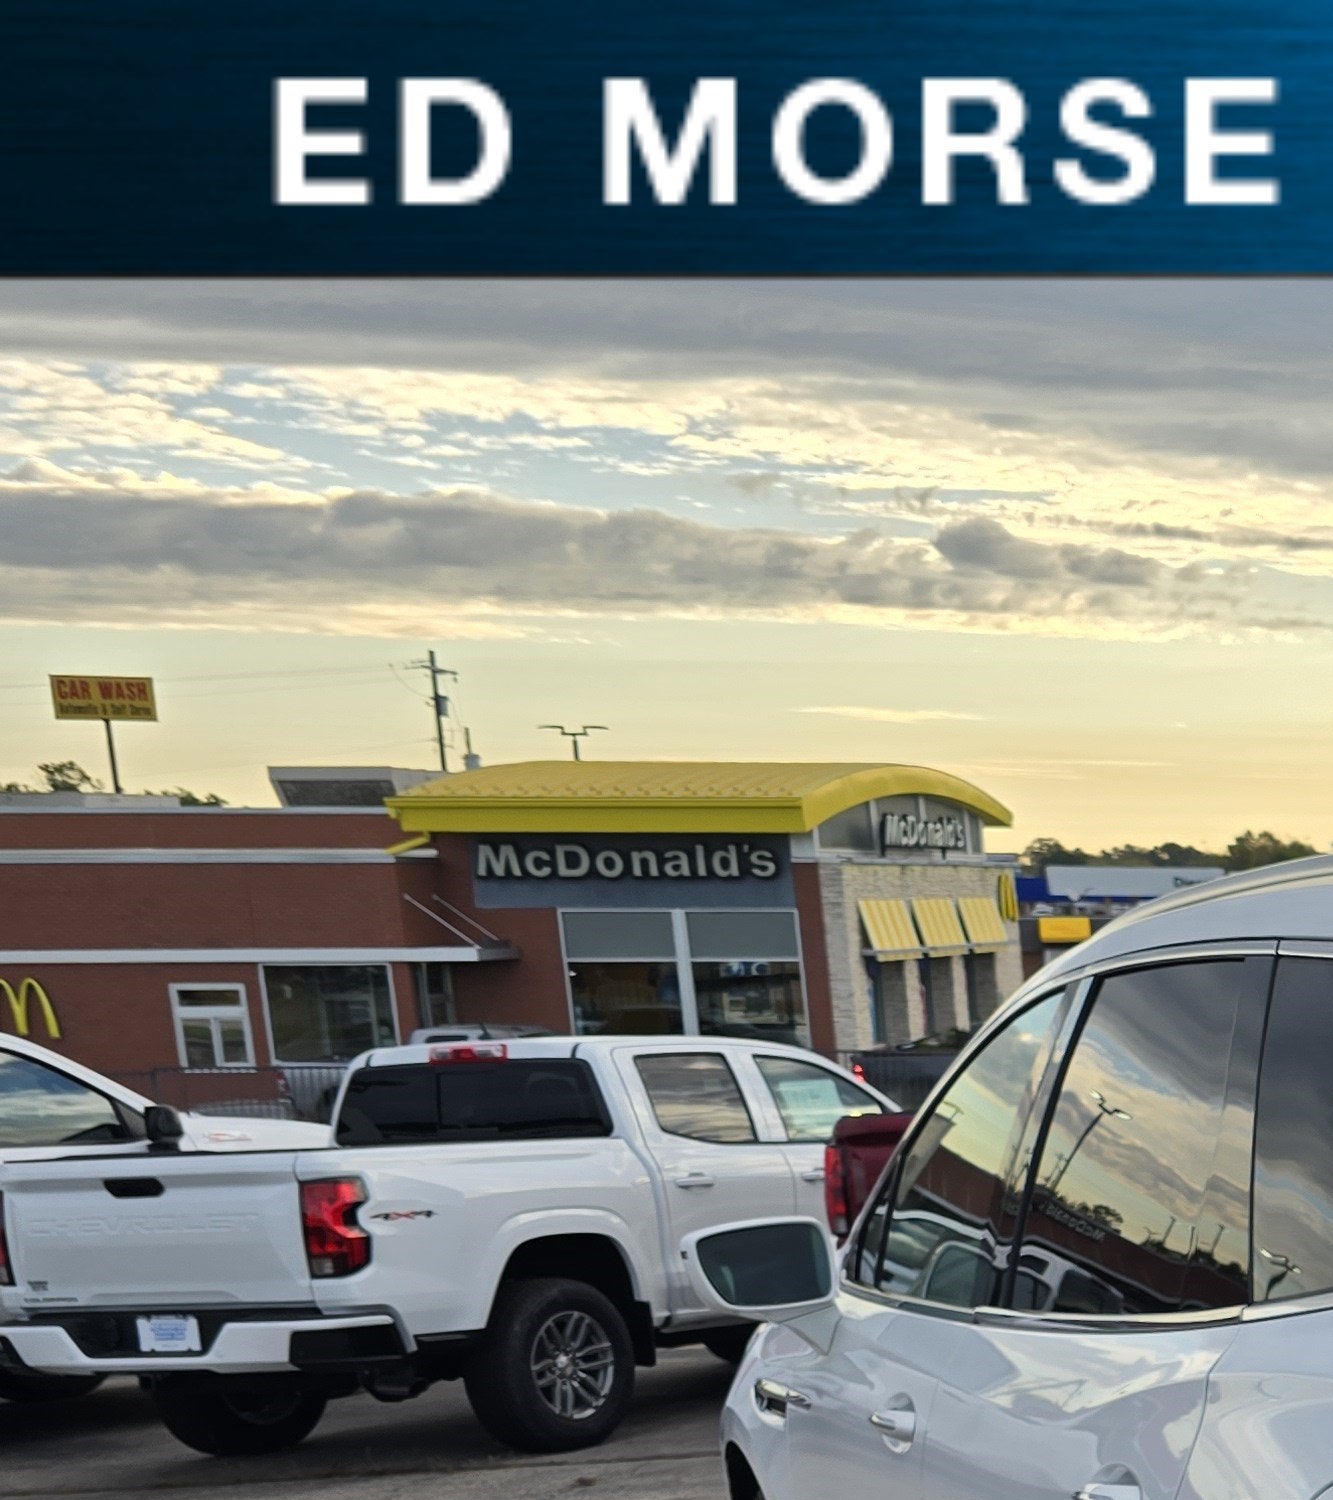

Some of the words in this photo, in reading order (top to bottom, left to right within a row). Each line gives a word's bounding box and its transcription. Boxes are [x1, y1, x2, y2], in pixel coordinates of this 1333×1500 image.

[56, 679, 91, 700] CAR
[98, 681, 149, 702] WASH
[884, 813, 965, 849] McDonald's
[476, 842, 777, 879] McDonald's
